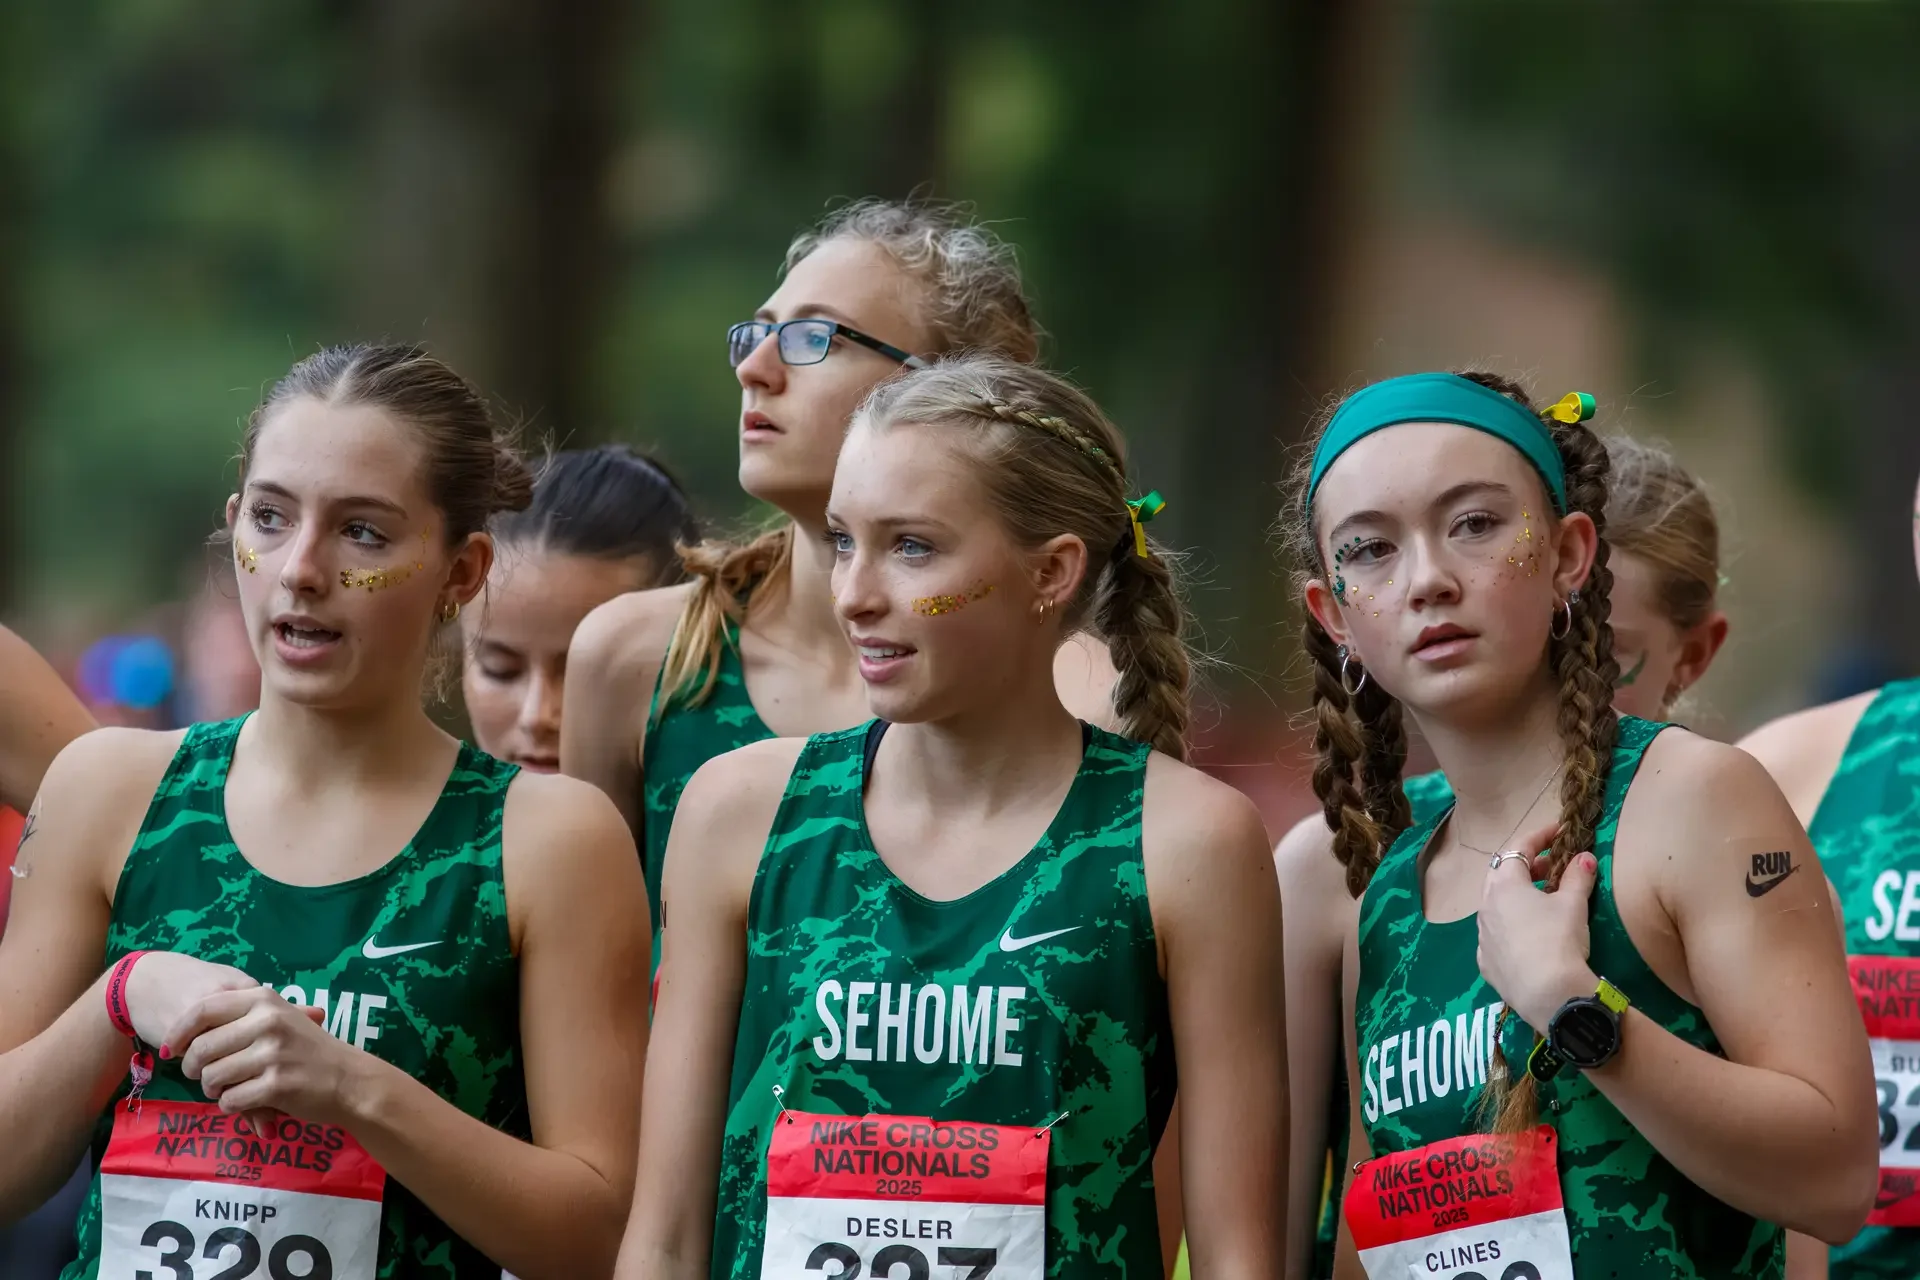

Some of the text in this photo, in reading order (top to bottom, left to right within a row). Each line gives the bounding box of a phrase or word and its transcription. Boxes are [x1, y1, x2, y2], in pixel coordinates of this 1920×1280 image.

[1751, 851, 1792, 876] RUN
[111, 978, 122, 1014] CROSS
[813, 979, 1026, 1067] SEHOME
[1364, 1001, 1508, 1123] SEHOME
[157, 1112, 345, 1151] NIKE COSS
[809, 1121, 999, 1151] NIKE CROSS
[155, 1136, 333, 1173] NATIONALS
[814, 1148, 990, 1179] NATIONALS
[1373, 1141, 1515, 1193] NIKE CROSS
[214, 1162, 263, 1181] 2025
[875, 1178, 923, 1196] 2025
[1377, 1169, 1514, 1220] NATIONALS
[195, 1198, 277, 1224] KNIPP
[1431, 1206, 1470, 1229] 2025
[846, 1217, 953, 1240] DESLER
[1425, 1239, 1502, 1273] CLINES
